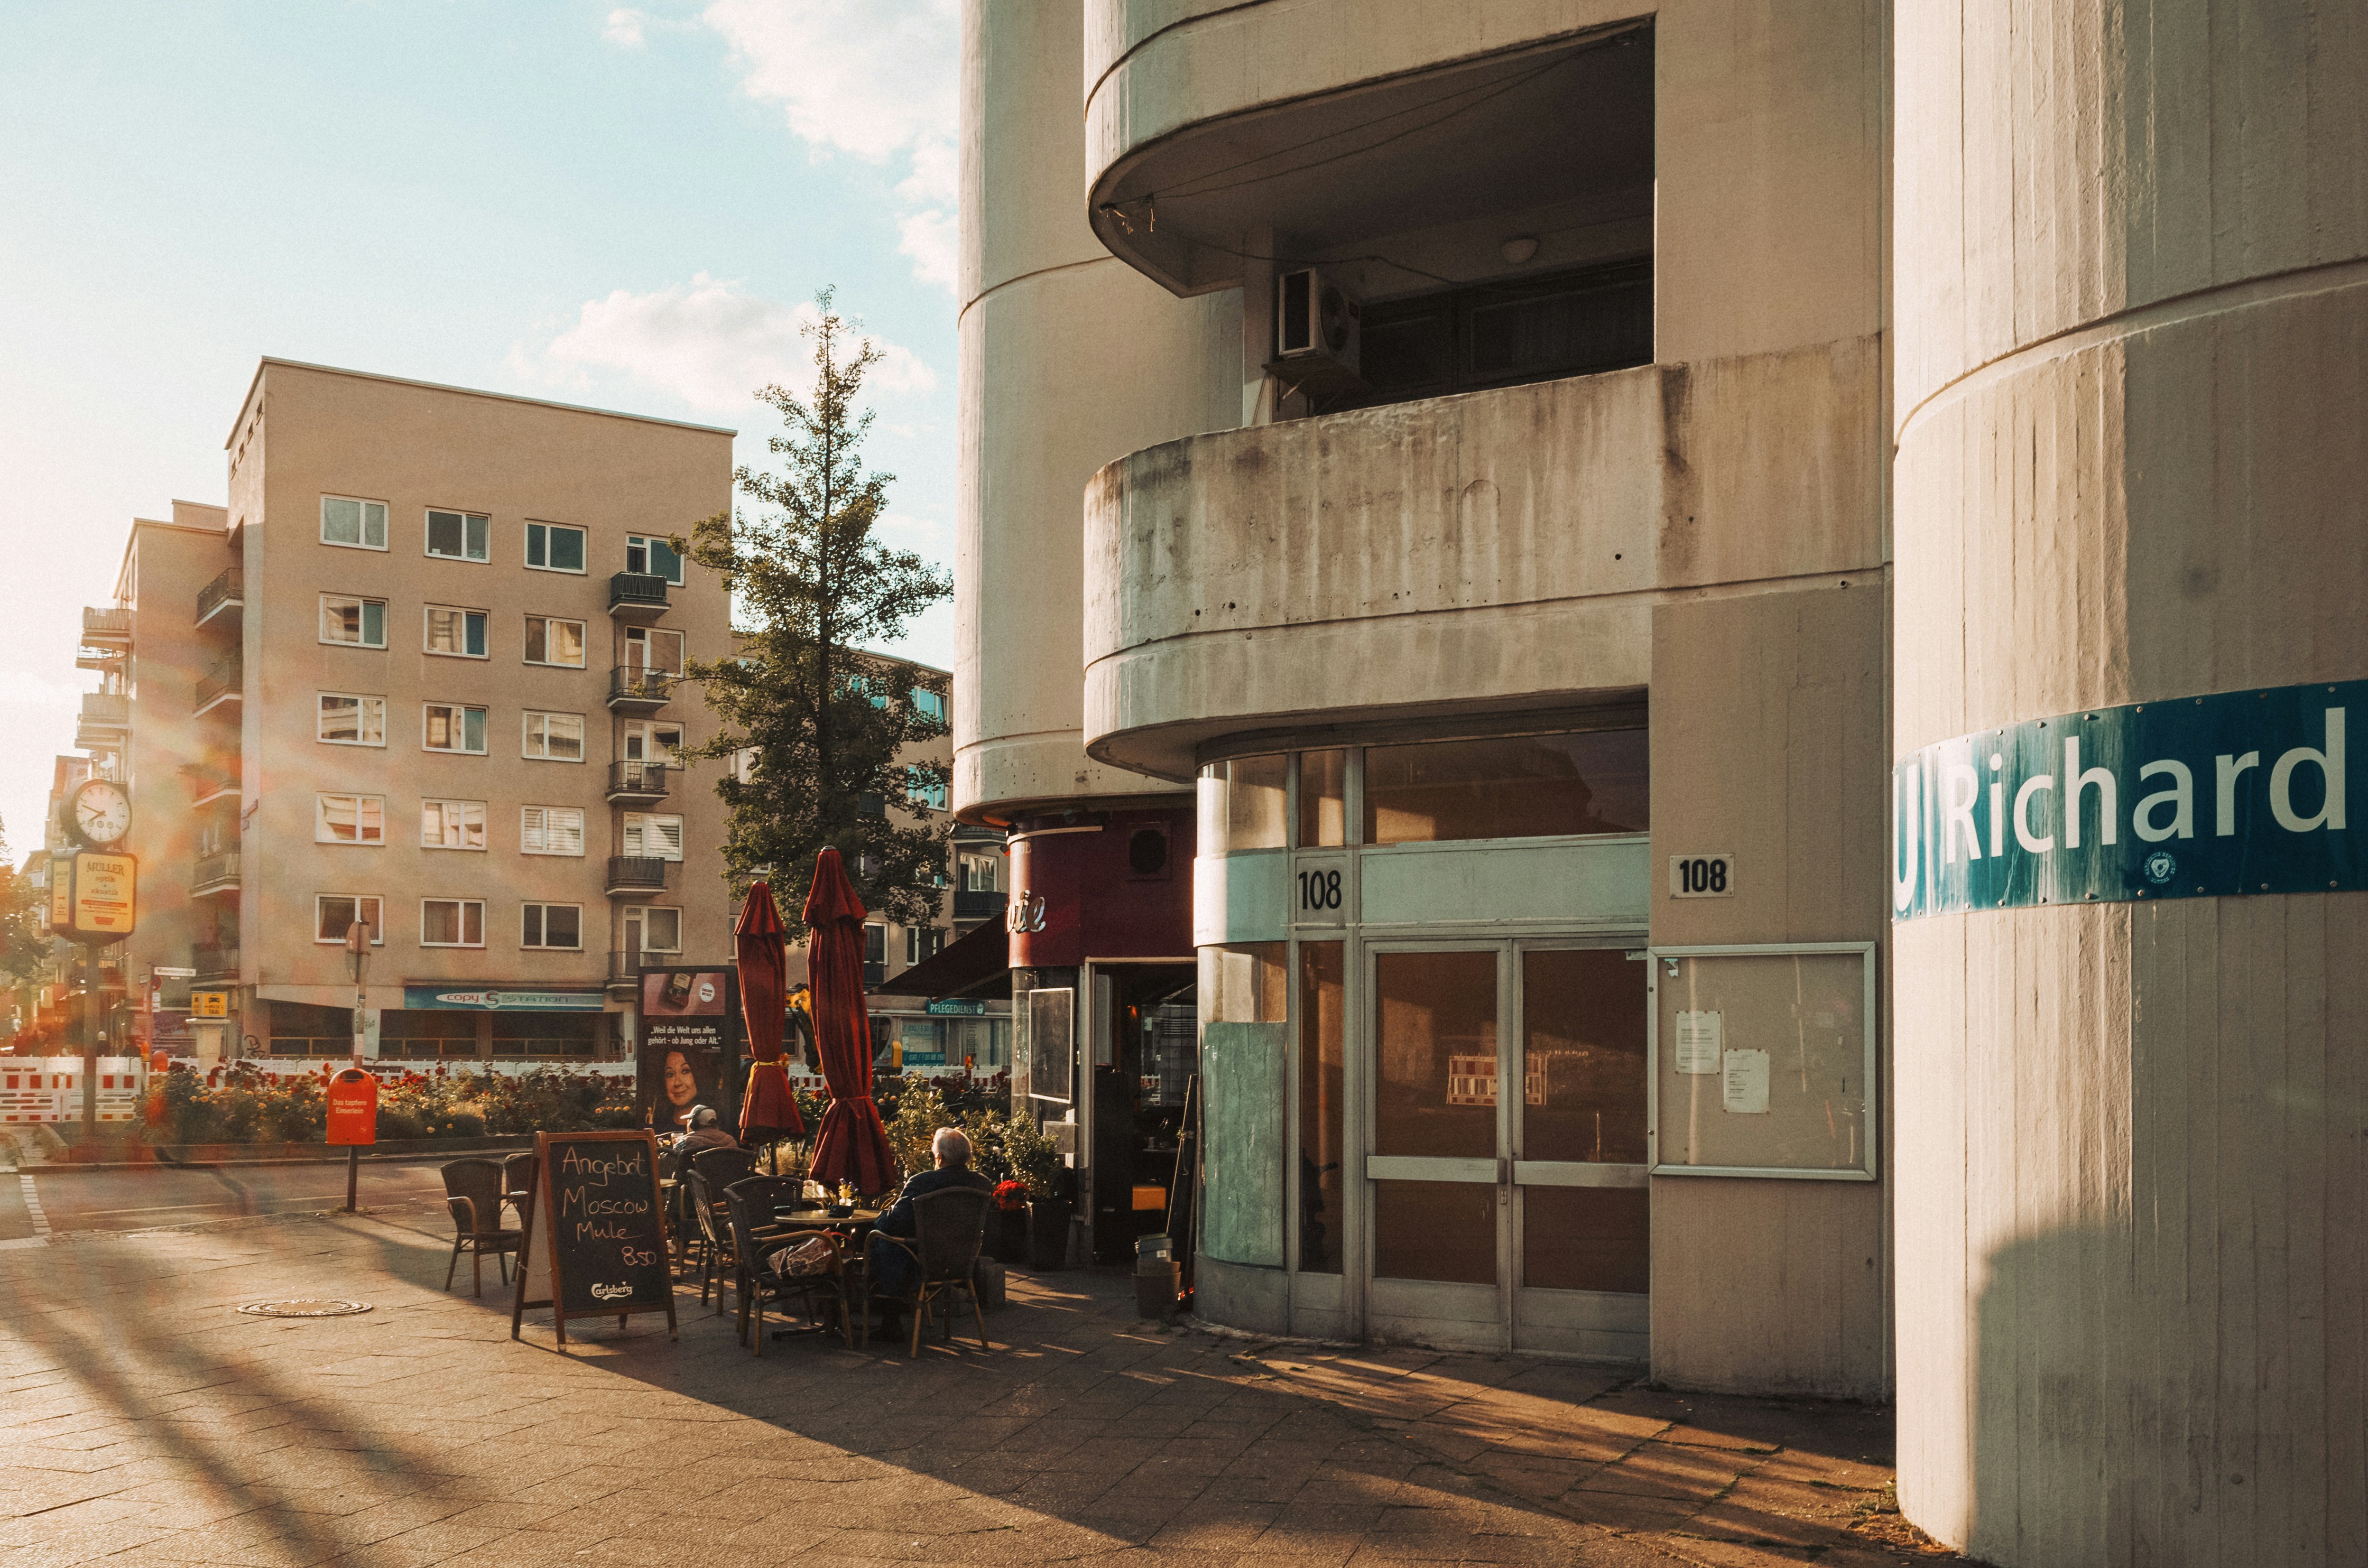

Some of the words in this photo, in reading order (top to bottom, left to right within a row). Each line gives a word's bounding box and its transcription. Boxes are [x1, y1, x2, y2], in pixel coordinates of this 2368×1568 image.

[1946, 707, 2346, 864] Richard
[87, 860, 124, 876] MÜLLER
[1679, 859, 1726, 893] 108
[1298, 870, 1342, 910] 108
[930, 1004, 976, 1014] PFLEGEDIENST
[648, 1036, 667, 1046] gehört
[680, 1036, 693, 1046] Jung
[563, 1146, 648, 1186] Angebot
[563, 1185, 648, 1218] Moscow
[577, 1221, 644, 1242] Mule
[591, 1282, 634, 1298] Carlsberg
